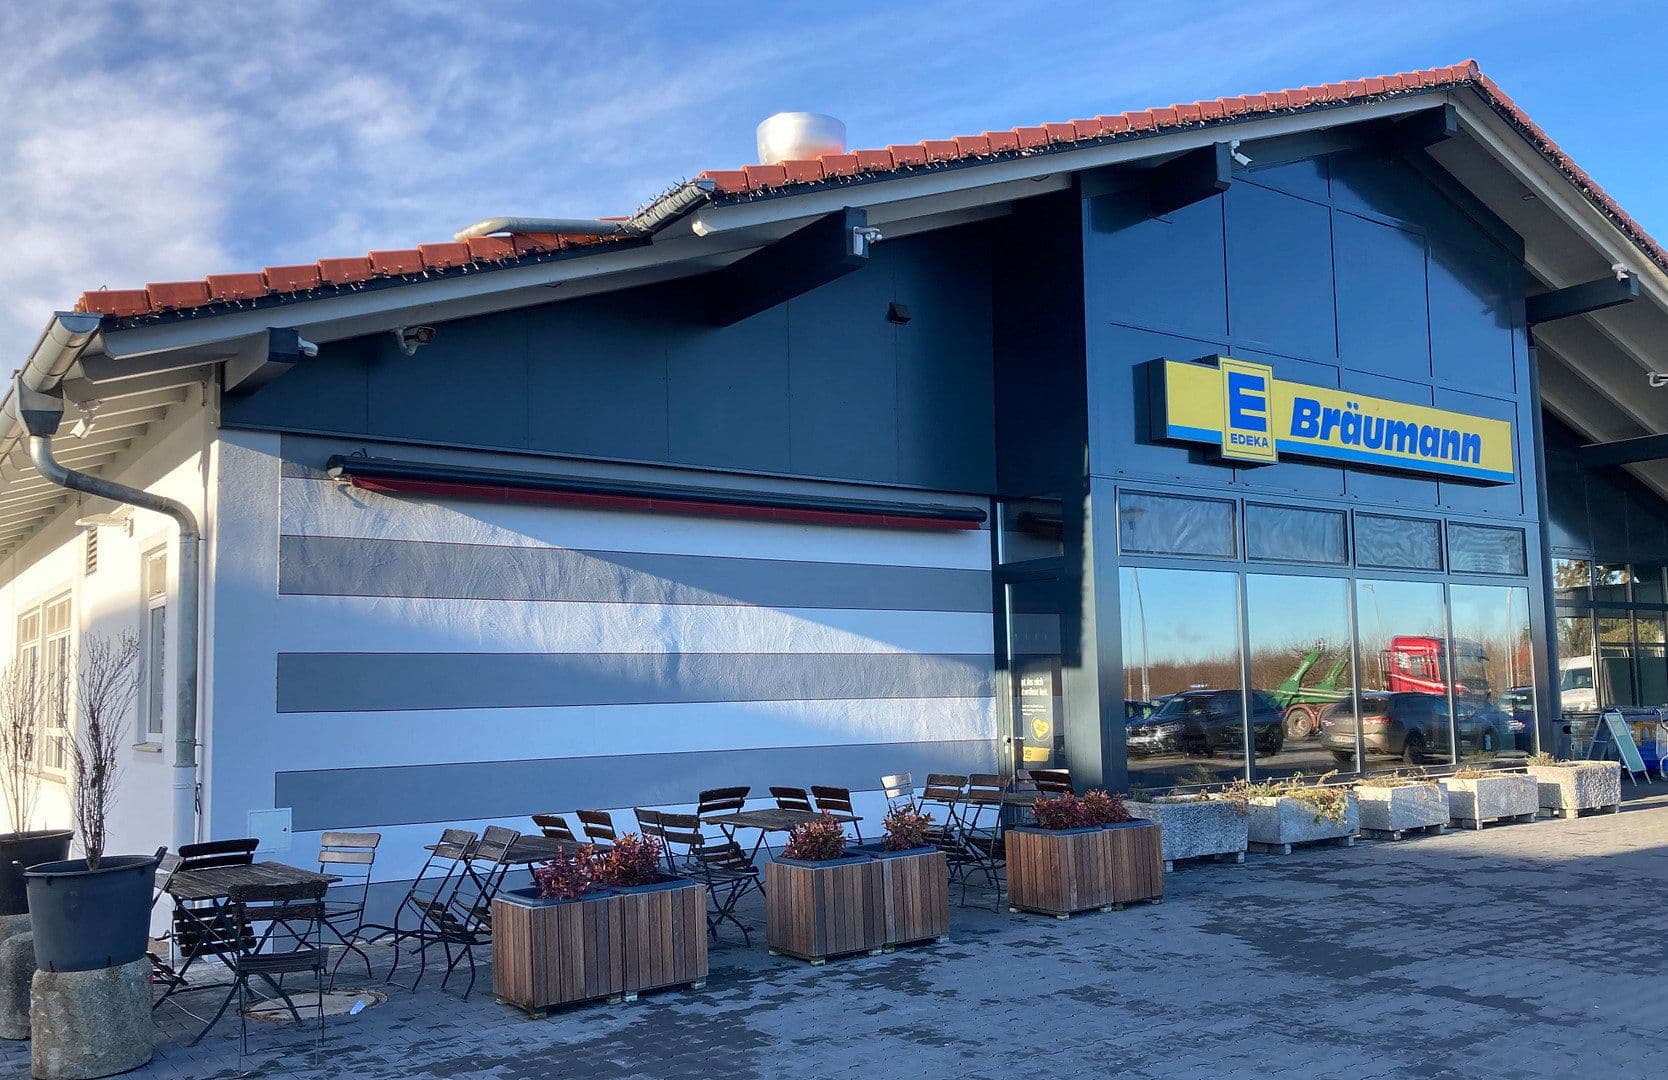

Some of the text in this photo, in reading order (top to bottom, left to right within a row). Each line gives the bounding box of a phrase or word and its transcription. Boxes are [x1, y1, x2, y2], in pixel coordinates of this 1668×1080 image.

[1228, 372, 1267, 432] E
[1290, 397, 1482, 464] Bräumann
[1230, 433, 1268, 448] EDEKA
